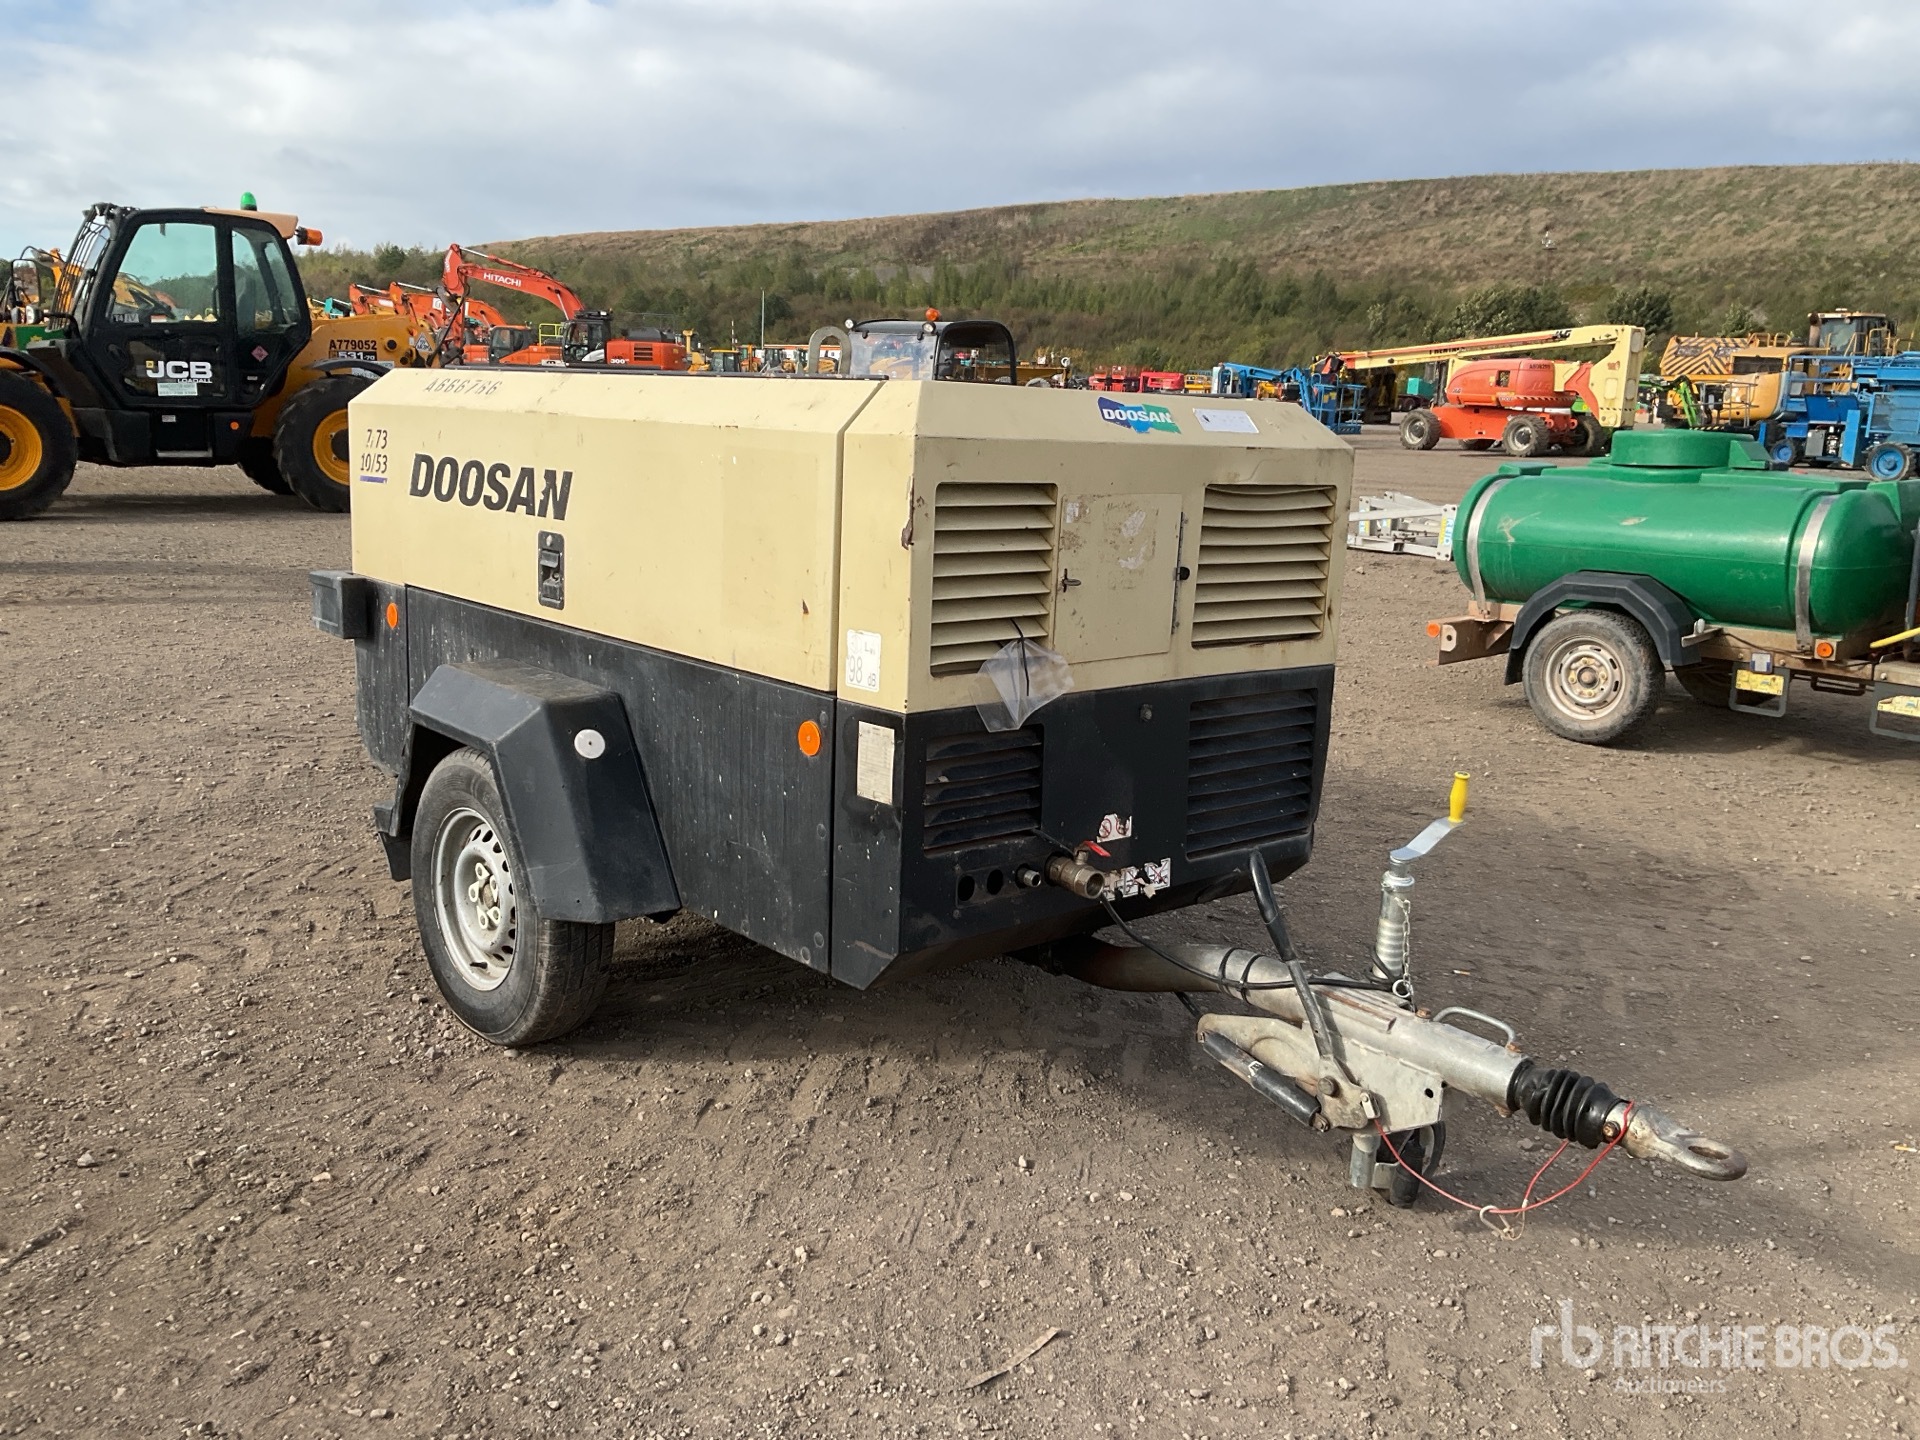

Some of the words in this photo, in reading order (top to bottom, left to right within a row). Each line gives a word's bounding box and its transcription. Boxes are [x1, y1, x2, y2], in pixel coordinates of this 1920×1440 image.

[483, 272, 522, 287] HITACHI
[329, 339, 377, 350] A779052
[338, 351, 375, 360] 531-70
[145, 360, 213, 378] JCB
[424, 378, 503, 395] A666766
[1102, 408, 1174, 424] DOOSAN
[360, 452, 388, 474] 10/53
[409, 453, 573, 521] DOOSAN
[848, 654, 863, 684] 98
[867, 673, 877, 688] dB
